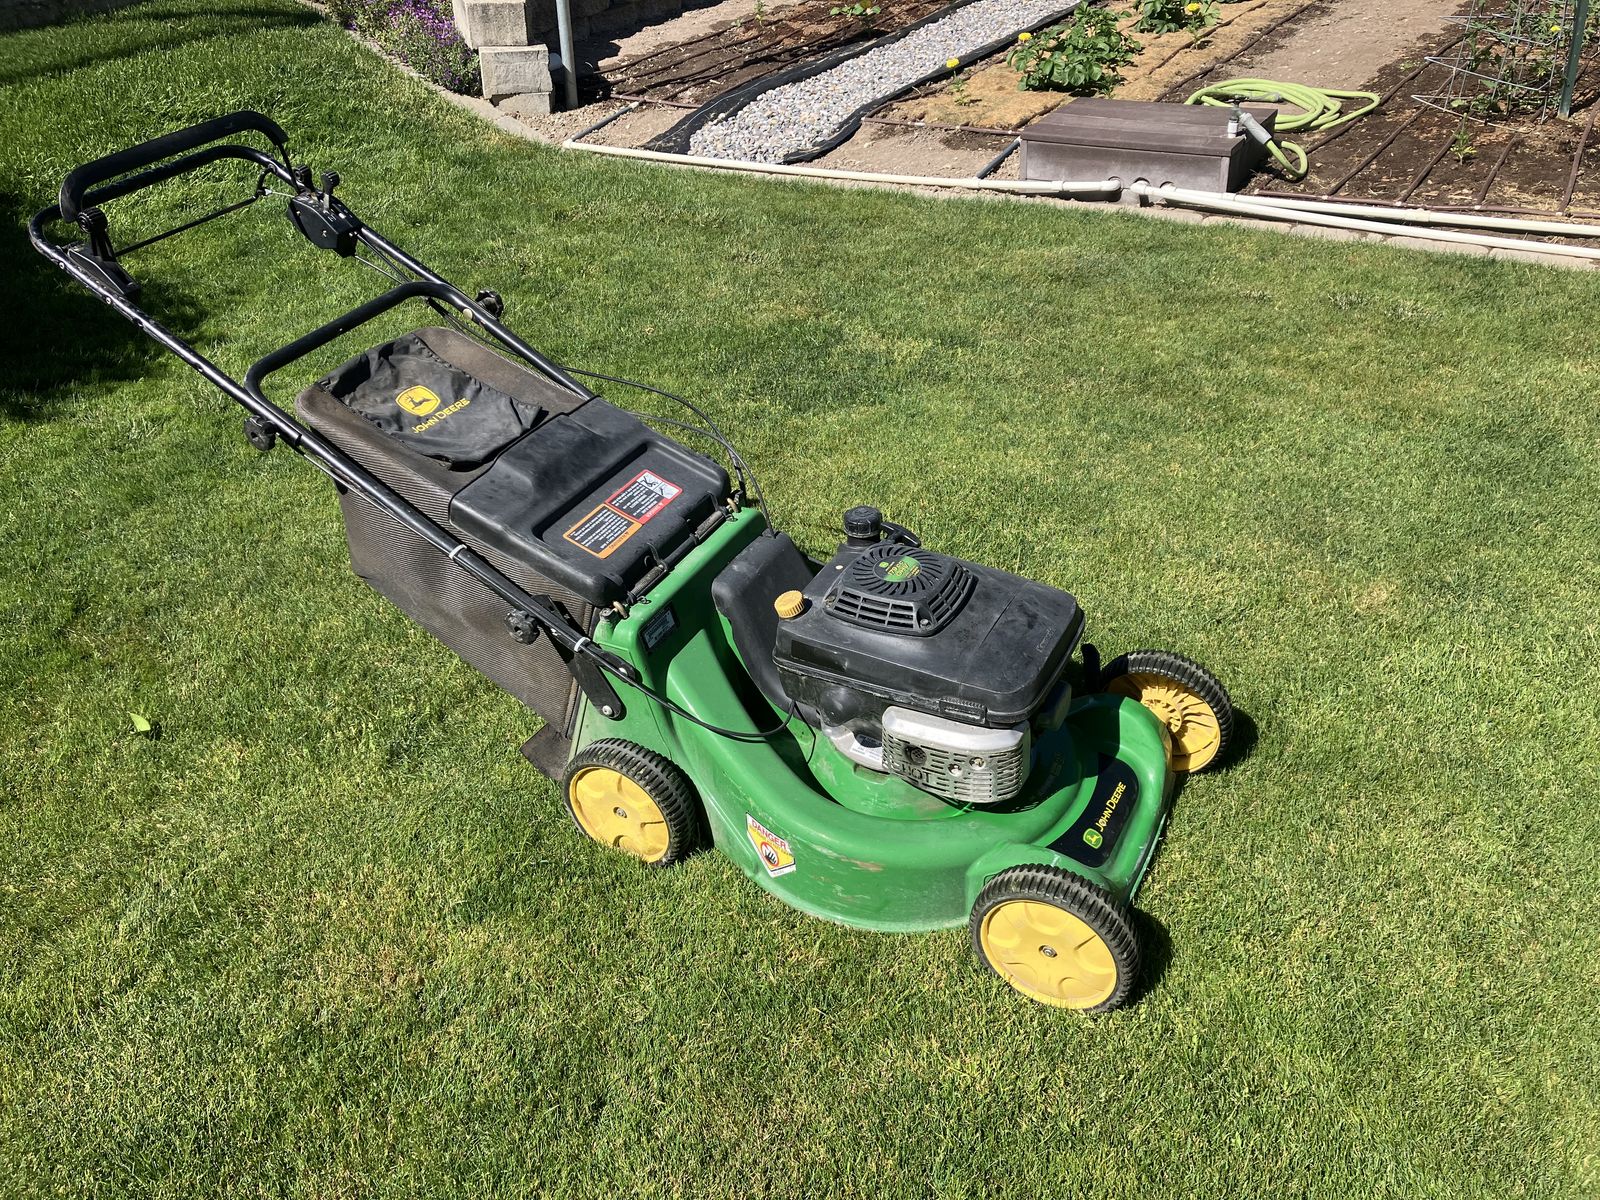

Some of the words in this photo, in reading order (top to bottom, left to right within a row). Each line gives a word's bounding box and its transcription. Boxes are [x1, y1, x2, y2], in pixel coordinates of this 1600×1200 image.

[411, 413, 439, 433] JOHN
[437, 397, 470, 419] DEERE
[902, 763, 931, 783] HOT
[1095, 807, 1113, 833] JOHN
[1106, 781, 1127, 810] DEERE
[751, 819, 787, 850] DANGER
